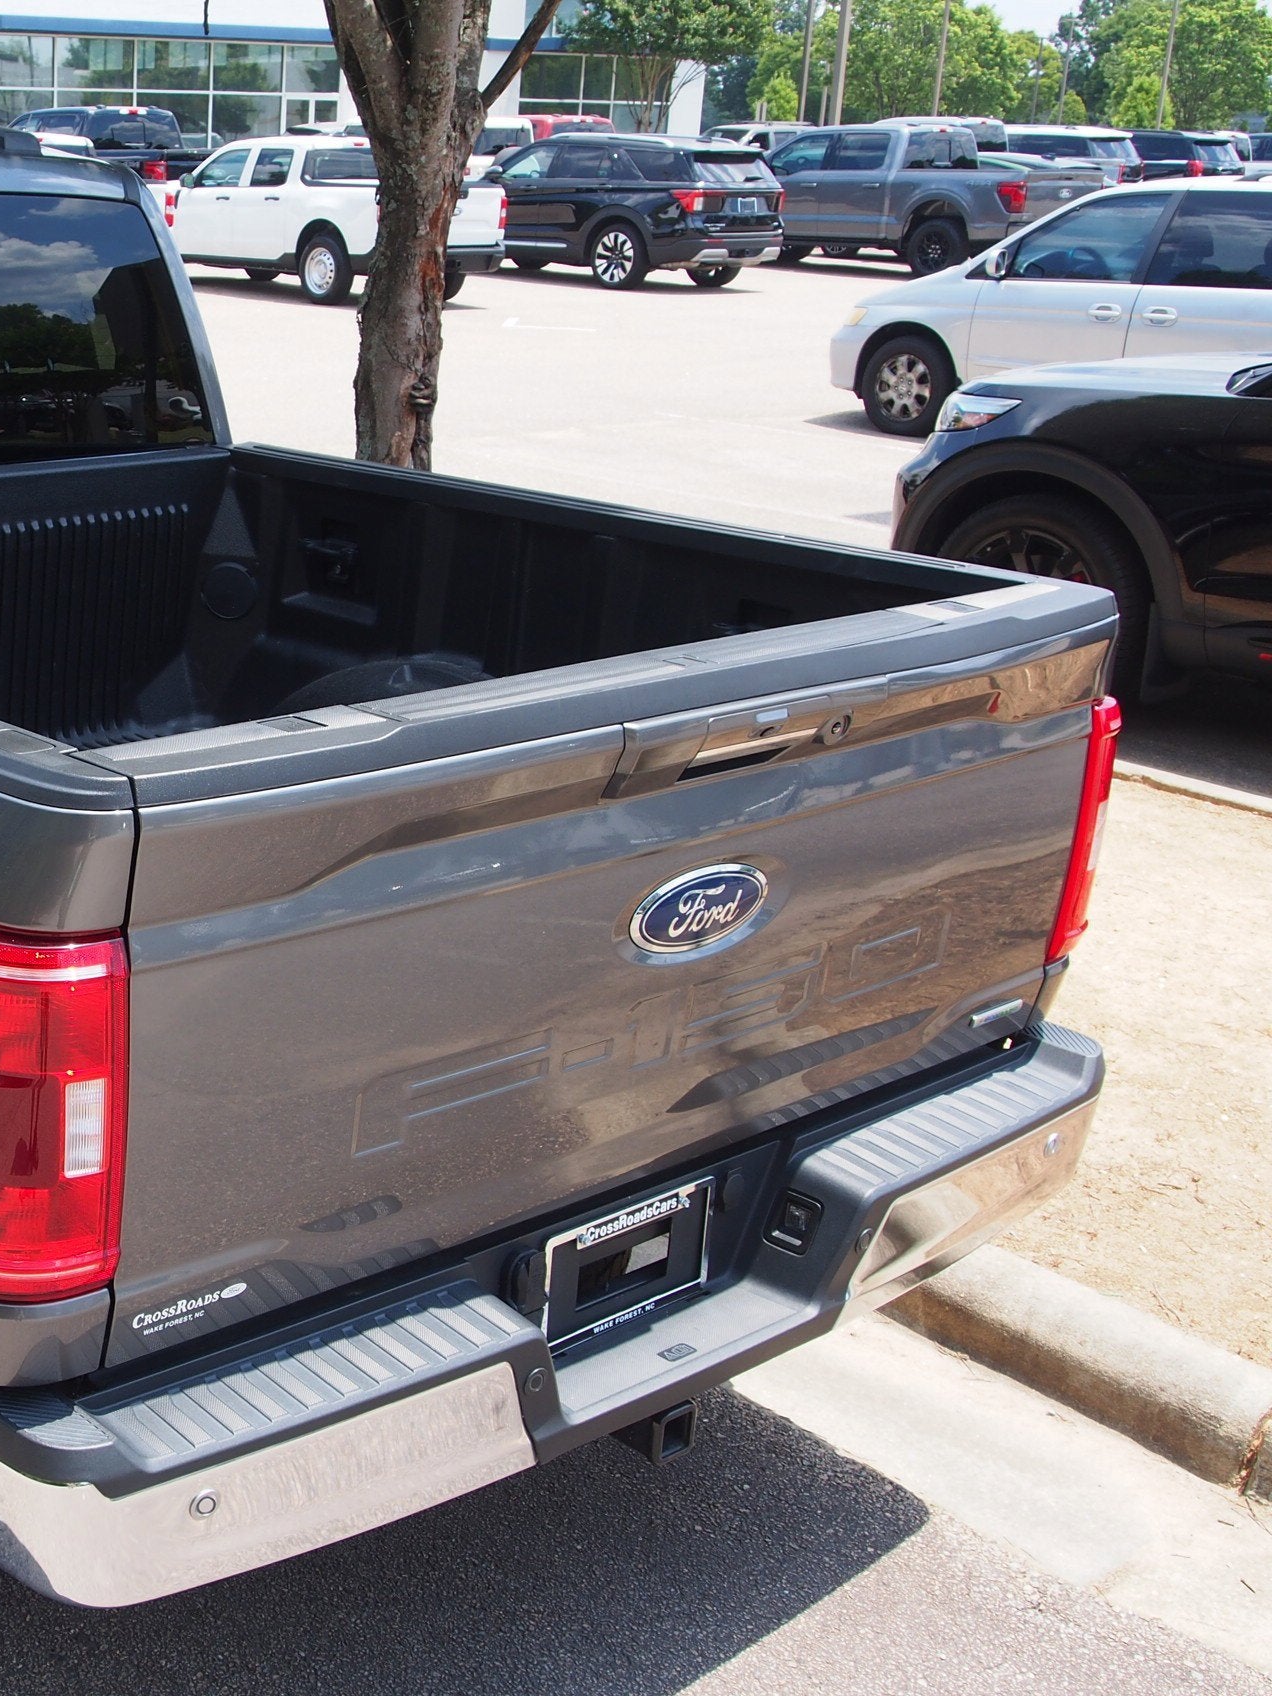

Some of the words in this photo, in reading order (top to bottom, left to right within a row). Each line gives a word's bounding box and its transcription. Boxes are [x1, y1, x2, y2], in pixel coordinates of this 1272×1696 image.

[668, 883, 743, 938] Ford
[352, 905, 951, 1158] F-150
[143, 1323, 164, 1336] WAKE
[164, 1314, 193, 1329] FOREST,
[194, 1310, 205, 1319] NC
[593, 1320, 614, 1334] WAKE
[615, 1308, 644, 1325] FOREST,
[645, 1302, 656, 1313] NC
